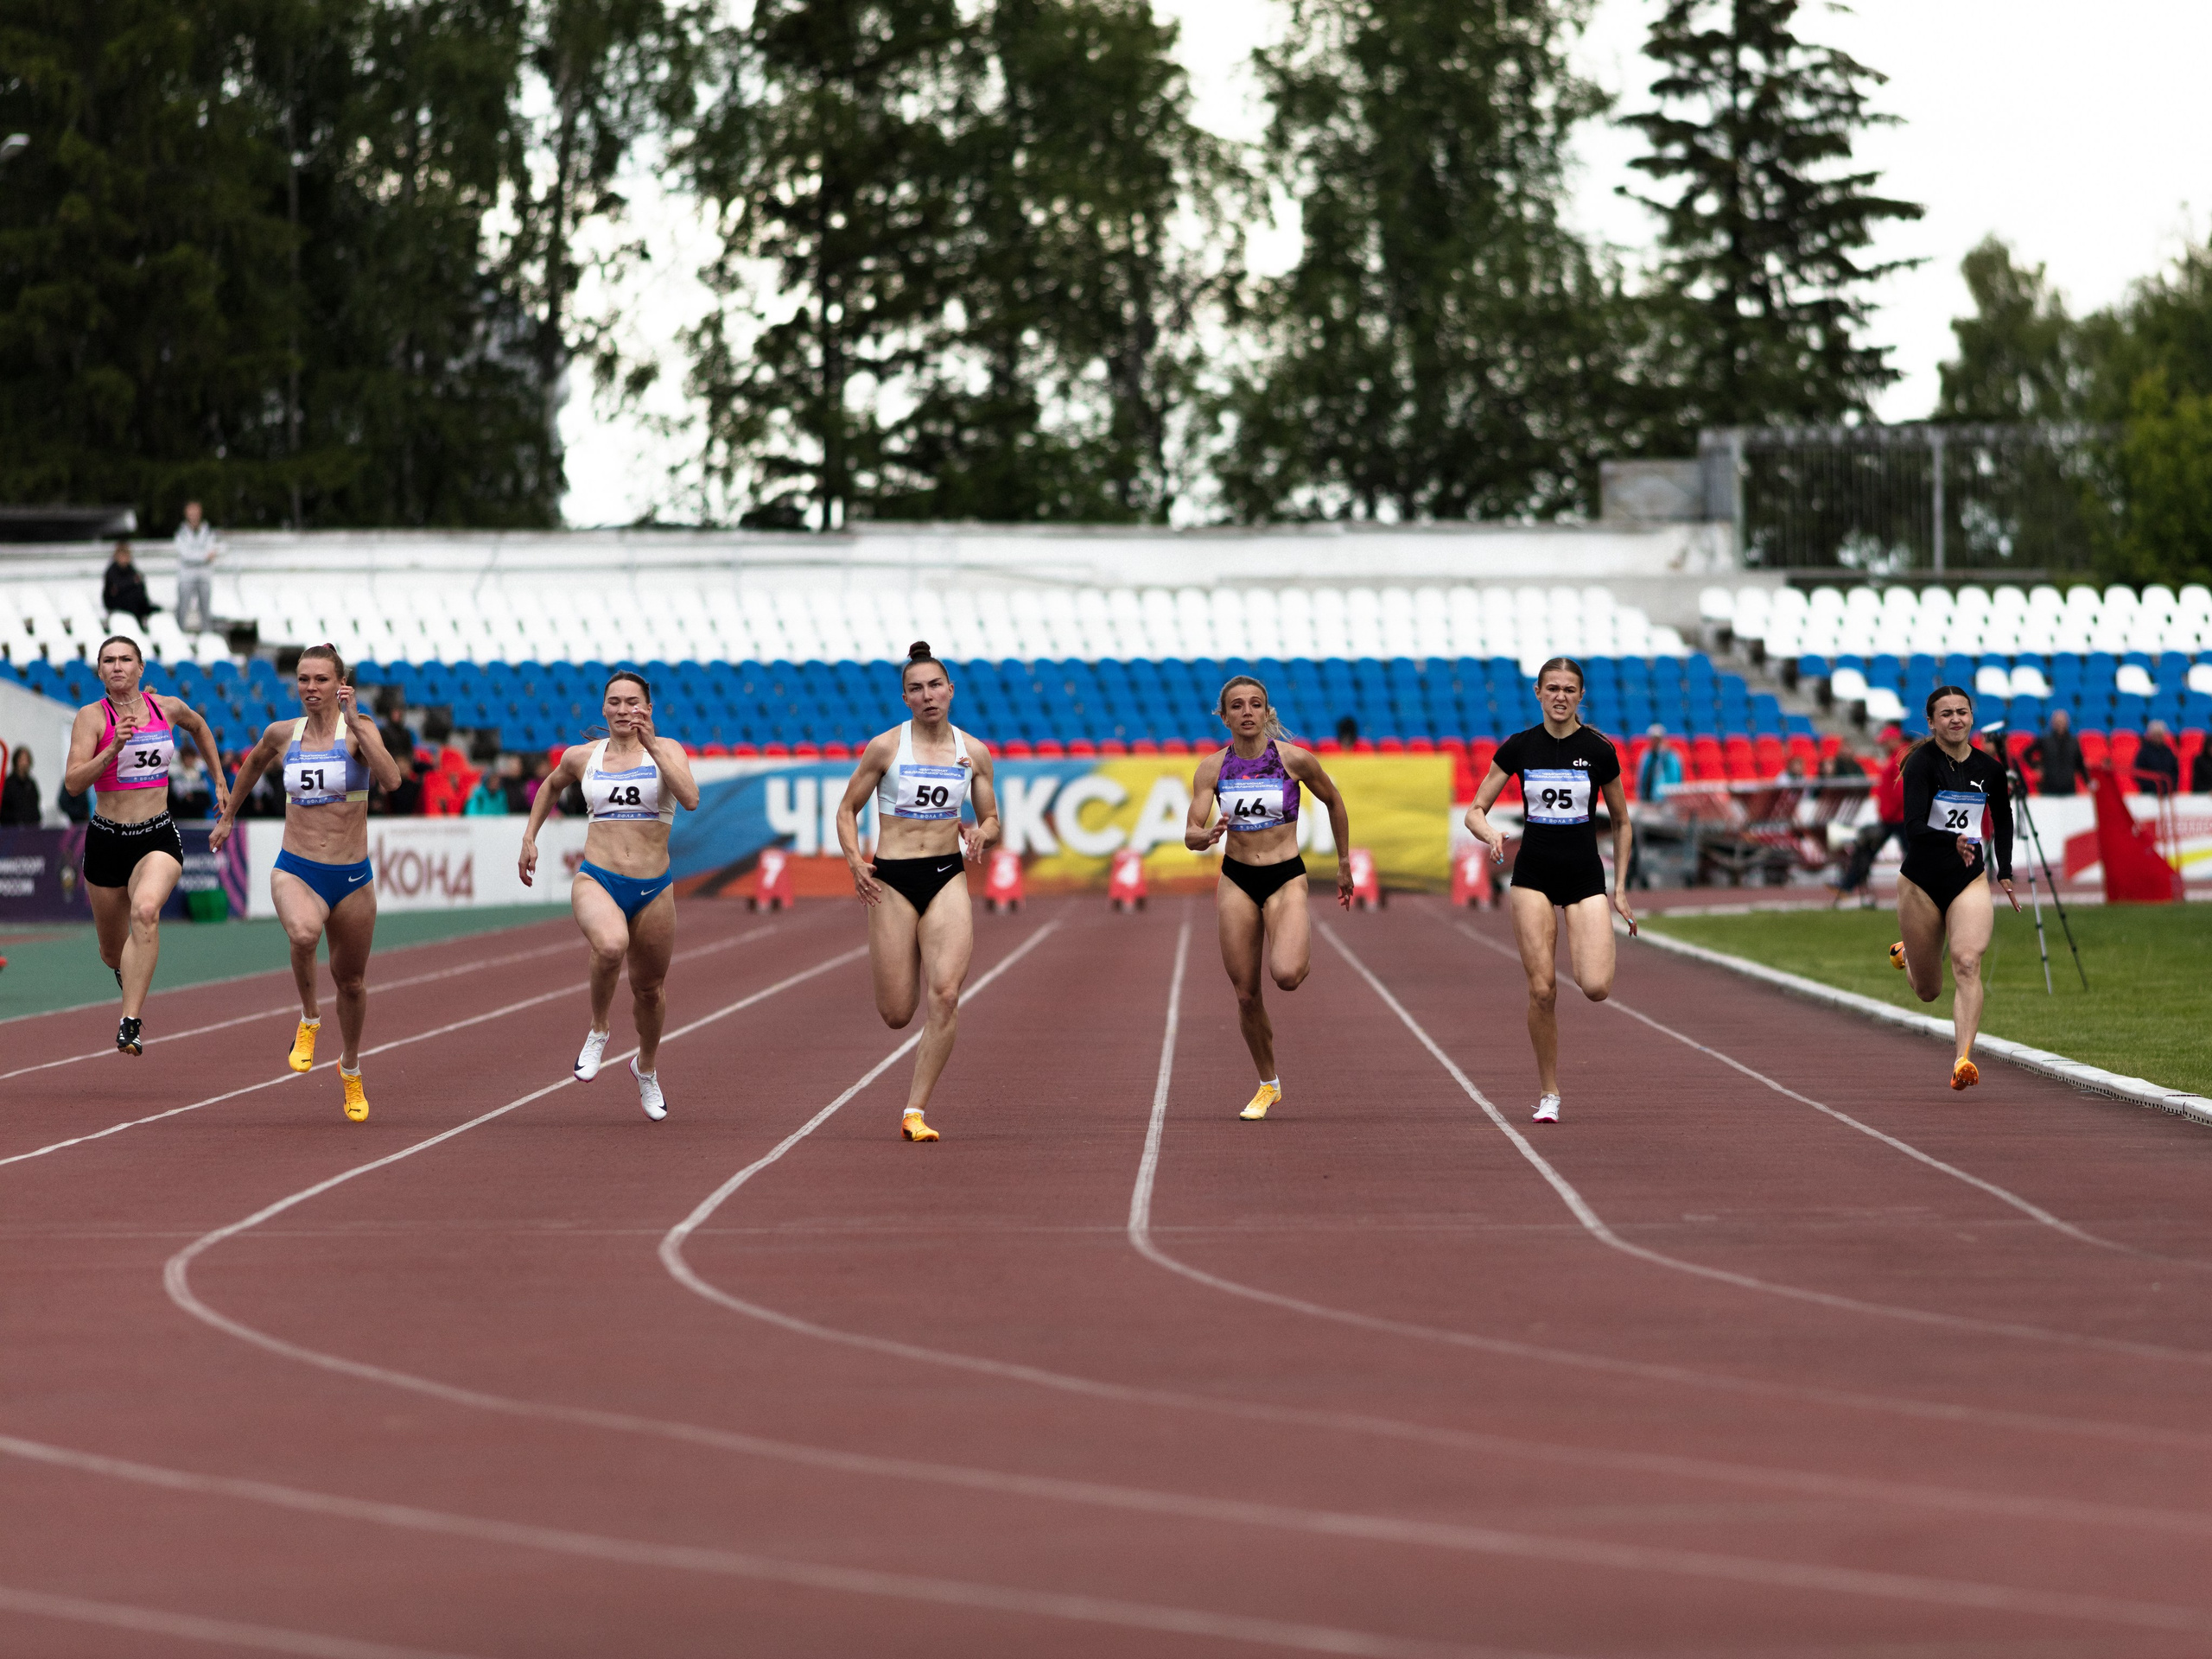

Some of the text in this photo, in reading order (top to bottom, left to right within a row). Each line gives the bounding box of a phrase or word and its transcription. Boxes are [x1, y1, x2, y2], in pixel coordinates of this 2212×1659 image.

[134, 749, 162, 768] 36
[301, 769, 324, 791] 51
[609, 786, 641, 805] 48
[915, 785, 949, 807] 50
[1541, 788, 1573, 809] 95
[1234, 798, 1266, 817] 46
[1945, 809, 1968, 829] 26
[761, 854, 785, 888] 7
[1116, 856, 1139, 887] 4
[1460, 855, 1480, 886] 1
